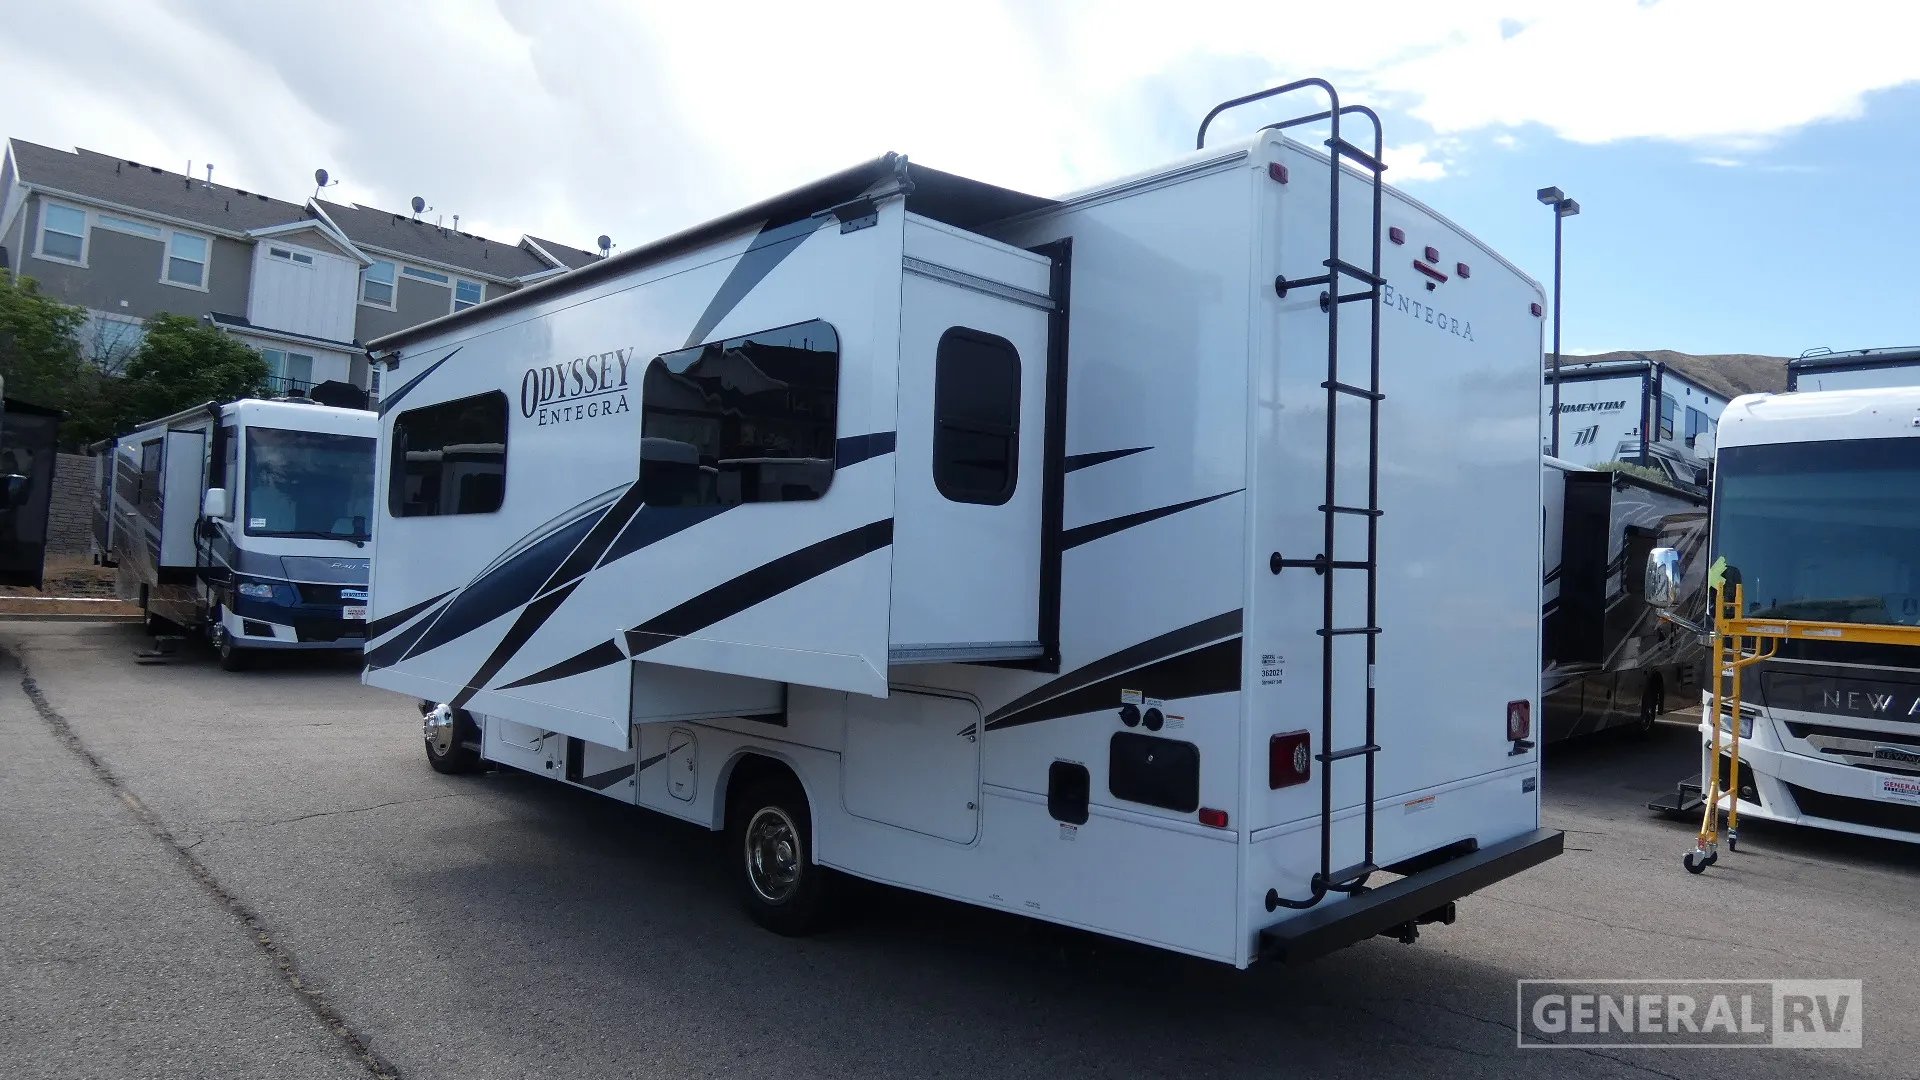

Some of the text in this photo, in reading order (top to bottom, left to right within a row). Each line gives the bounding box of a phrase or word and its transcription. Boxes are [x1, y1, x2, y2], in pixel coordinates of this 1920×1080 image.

[1382, 285, 1475, 342] ENTEGRA
[521, 347, 635, 419] ODYSSEY
[538, 394, 630, 427] ENTEGRA
[1823, 690, 1893, 713] NEW
